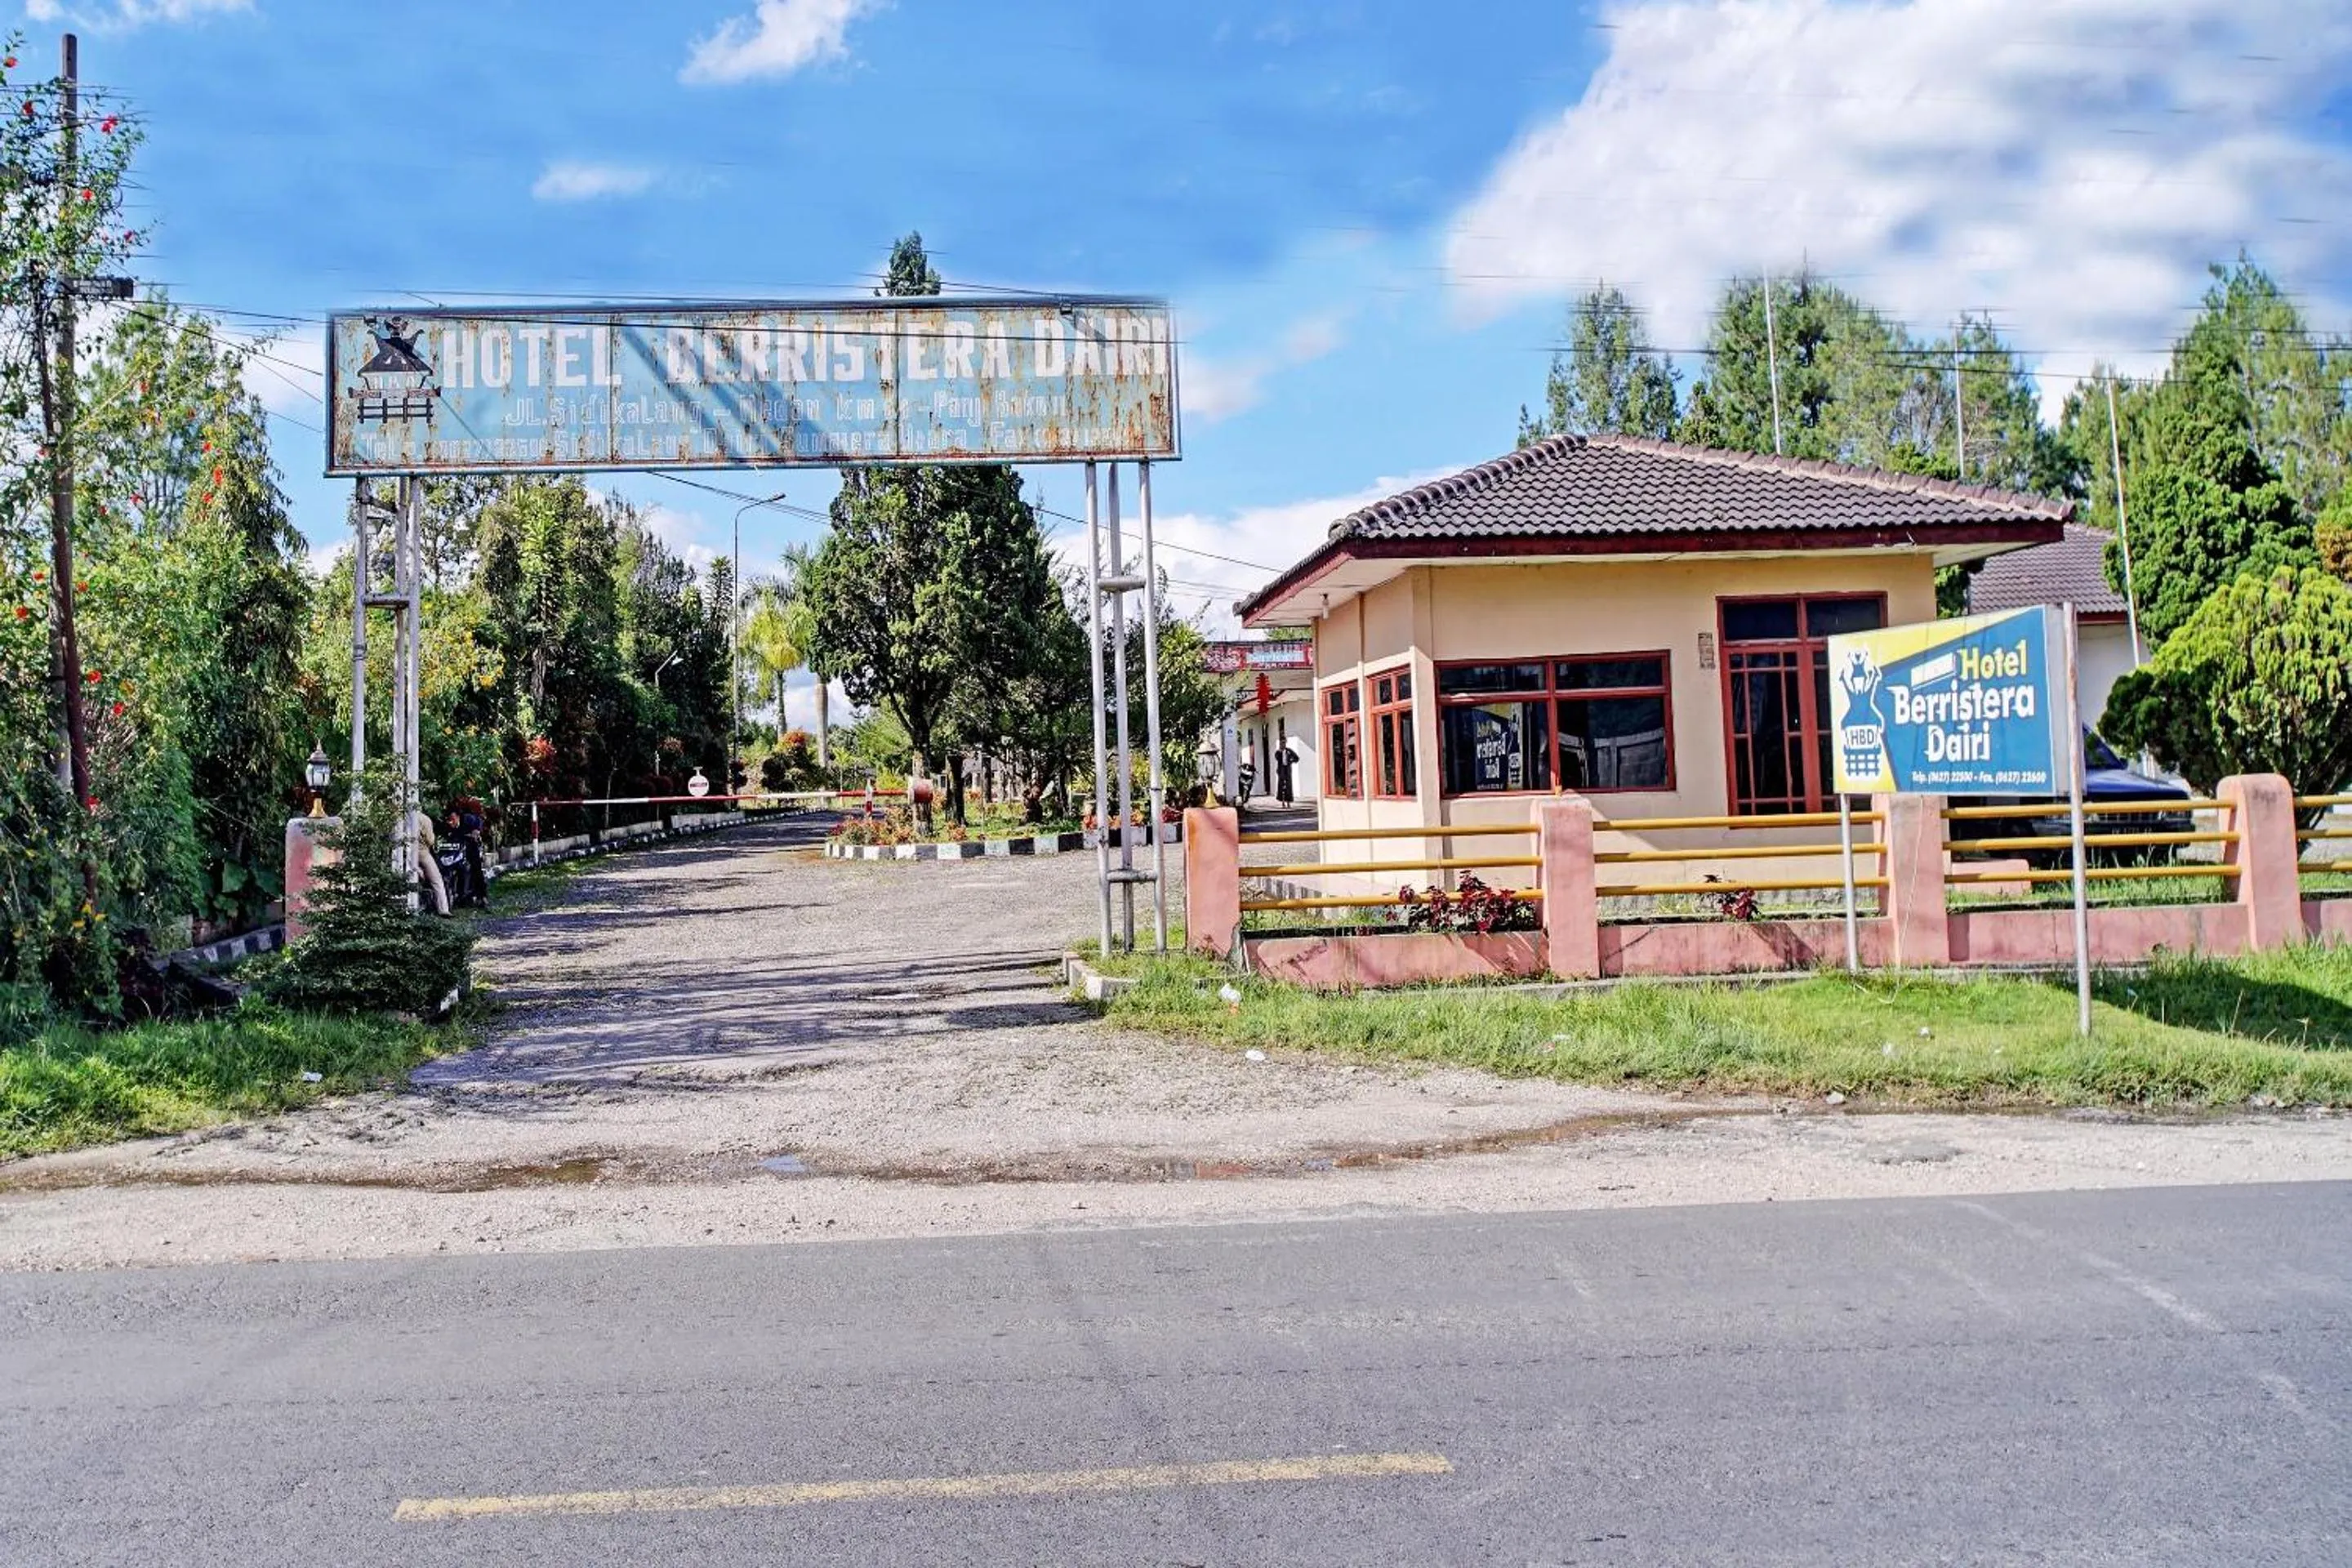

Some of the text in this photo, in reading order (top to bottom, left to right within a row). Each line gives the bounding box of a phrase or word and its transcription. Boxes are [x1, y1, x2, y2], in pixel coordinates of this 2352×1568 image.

[442, 317, 1166, 389] HOTEL BERRISTERA DAIRI
[1957, 639, 2027, 681] Hotel
[1886, 679, 2035, 725] Berristera
[1850, 728, 1875, 746] HBD
[1923, 719, 1992, 763] Dairi
